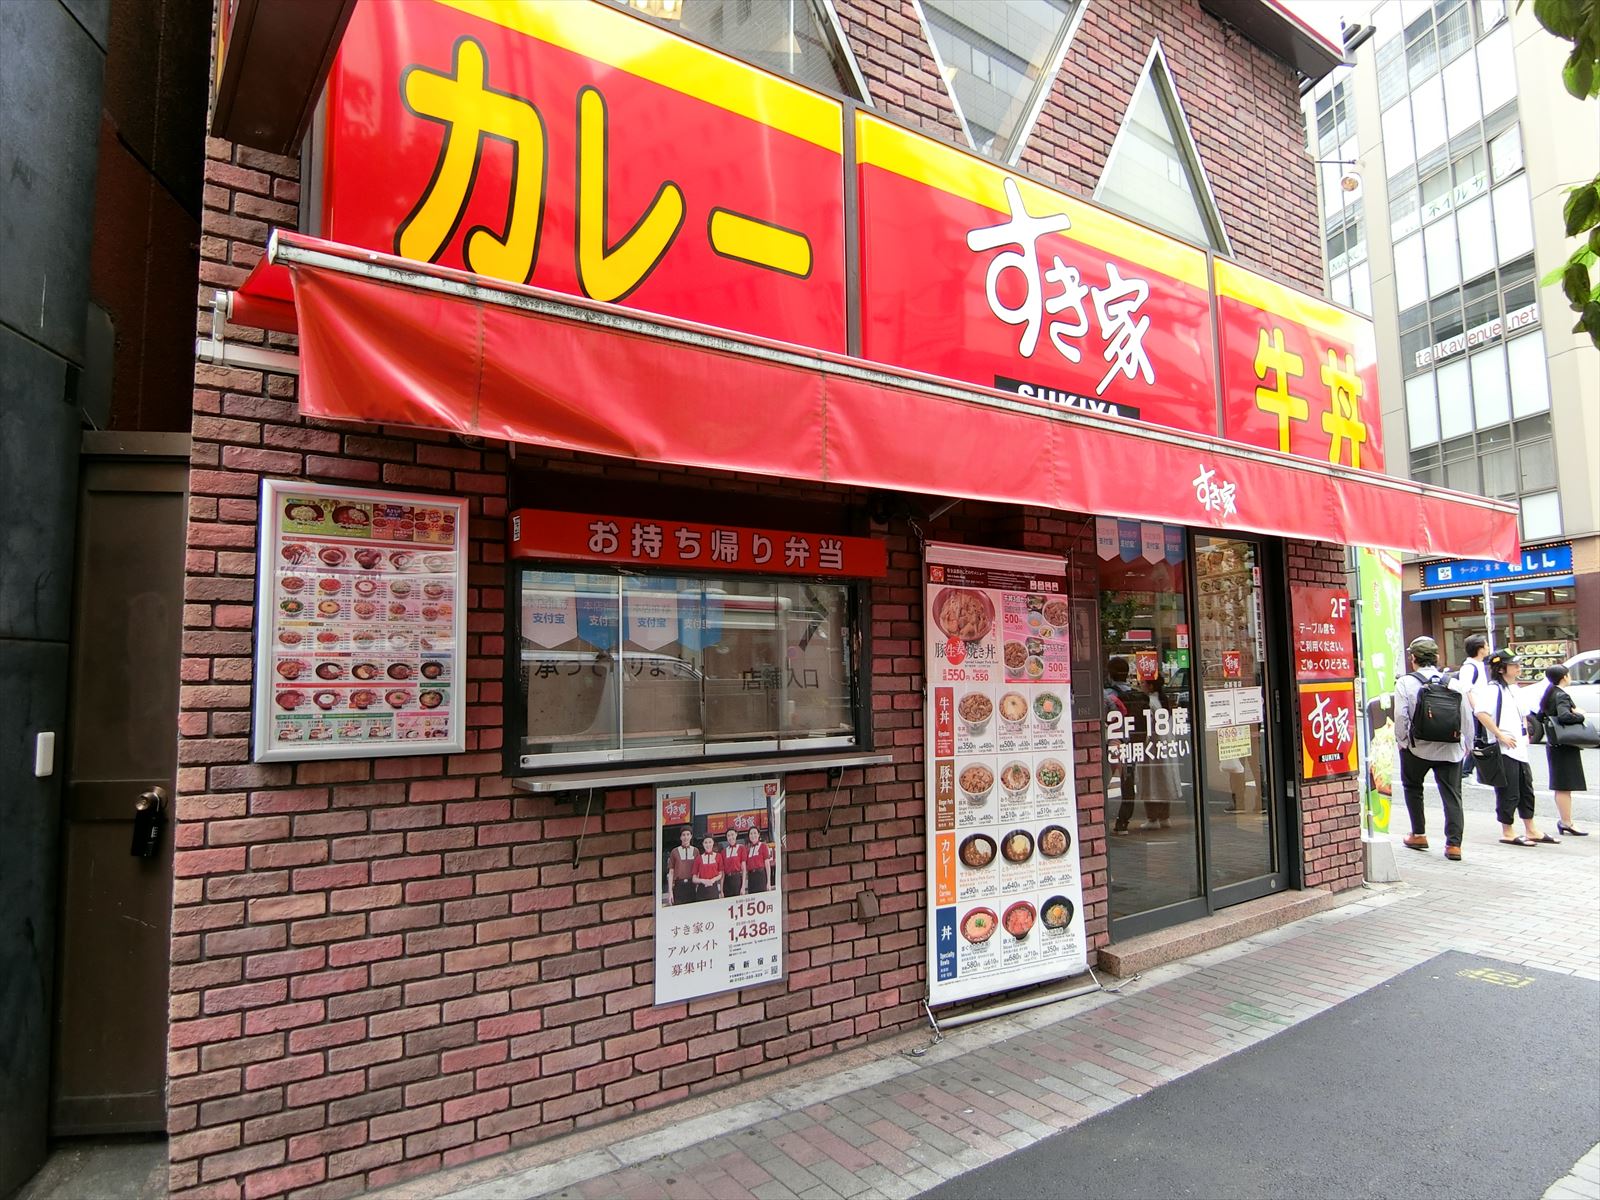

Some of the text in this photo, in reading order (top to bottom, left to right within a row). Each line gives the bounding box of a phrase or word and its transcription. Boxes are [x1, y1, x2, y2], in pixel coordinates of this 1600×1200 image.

[394, 35, 813, 302] カレー
[966, 177, 1155, 395] すき家
[1254, 327, 1367, 468] 牛丼
[1193, 464, 1237, 518] すき家
[588, 521, 843, 570] お持ち帰り弁当
[1330, 598, 1347, 618] 2F
[532, 613, 566, 624] 支付宝
[638, 618, 667, 628] 支付宝
[1299, 623, 1336, 634] テーブル席も
[1139, 655, 1155, 672] すき家
[940, 697, 949, 724] 牛丼
[1107, 711, 1136, 739] 2F
[1143, 707, 1189, 736] 18席
[1308, 693, 1350, 751] すき家
[1108, 740, 1190, 763] ご利用ください
[1321, 753, 1341, 762] SUKIYA
[940, 765, 951, 793] 豚丼
[665, 801, 687, 815] すき家
[734, 814, 756, 828] すき家
[941, 839, 950, 879] カレー
[728, 900, 774, 920] 1,150円
[671, 921, 715, 938] すき家の
[729, 922, 776, 942] 1,438円
[941, 925, 952, 940] 丼
[667, 939, 718, 959] アルバイト
[729, 955, 778, 972] 西新宿店
